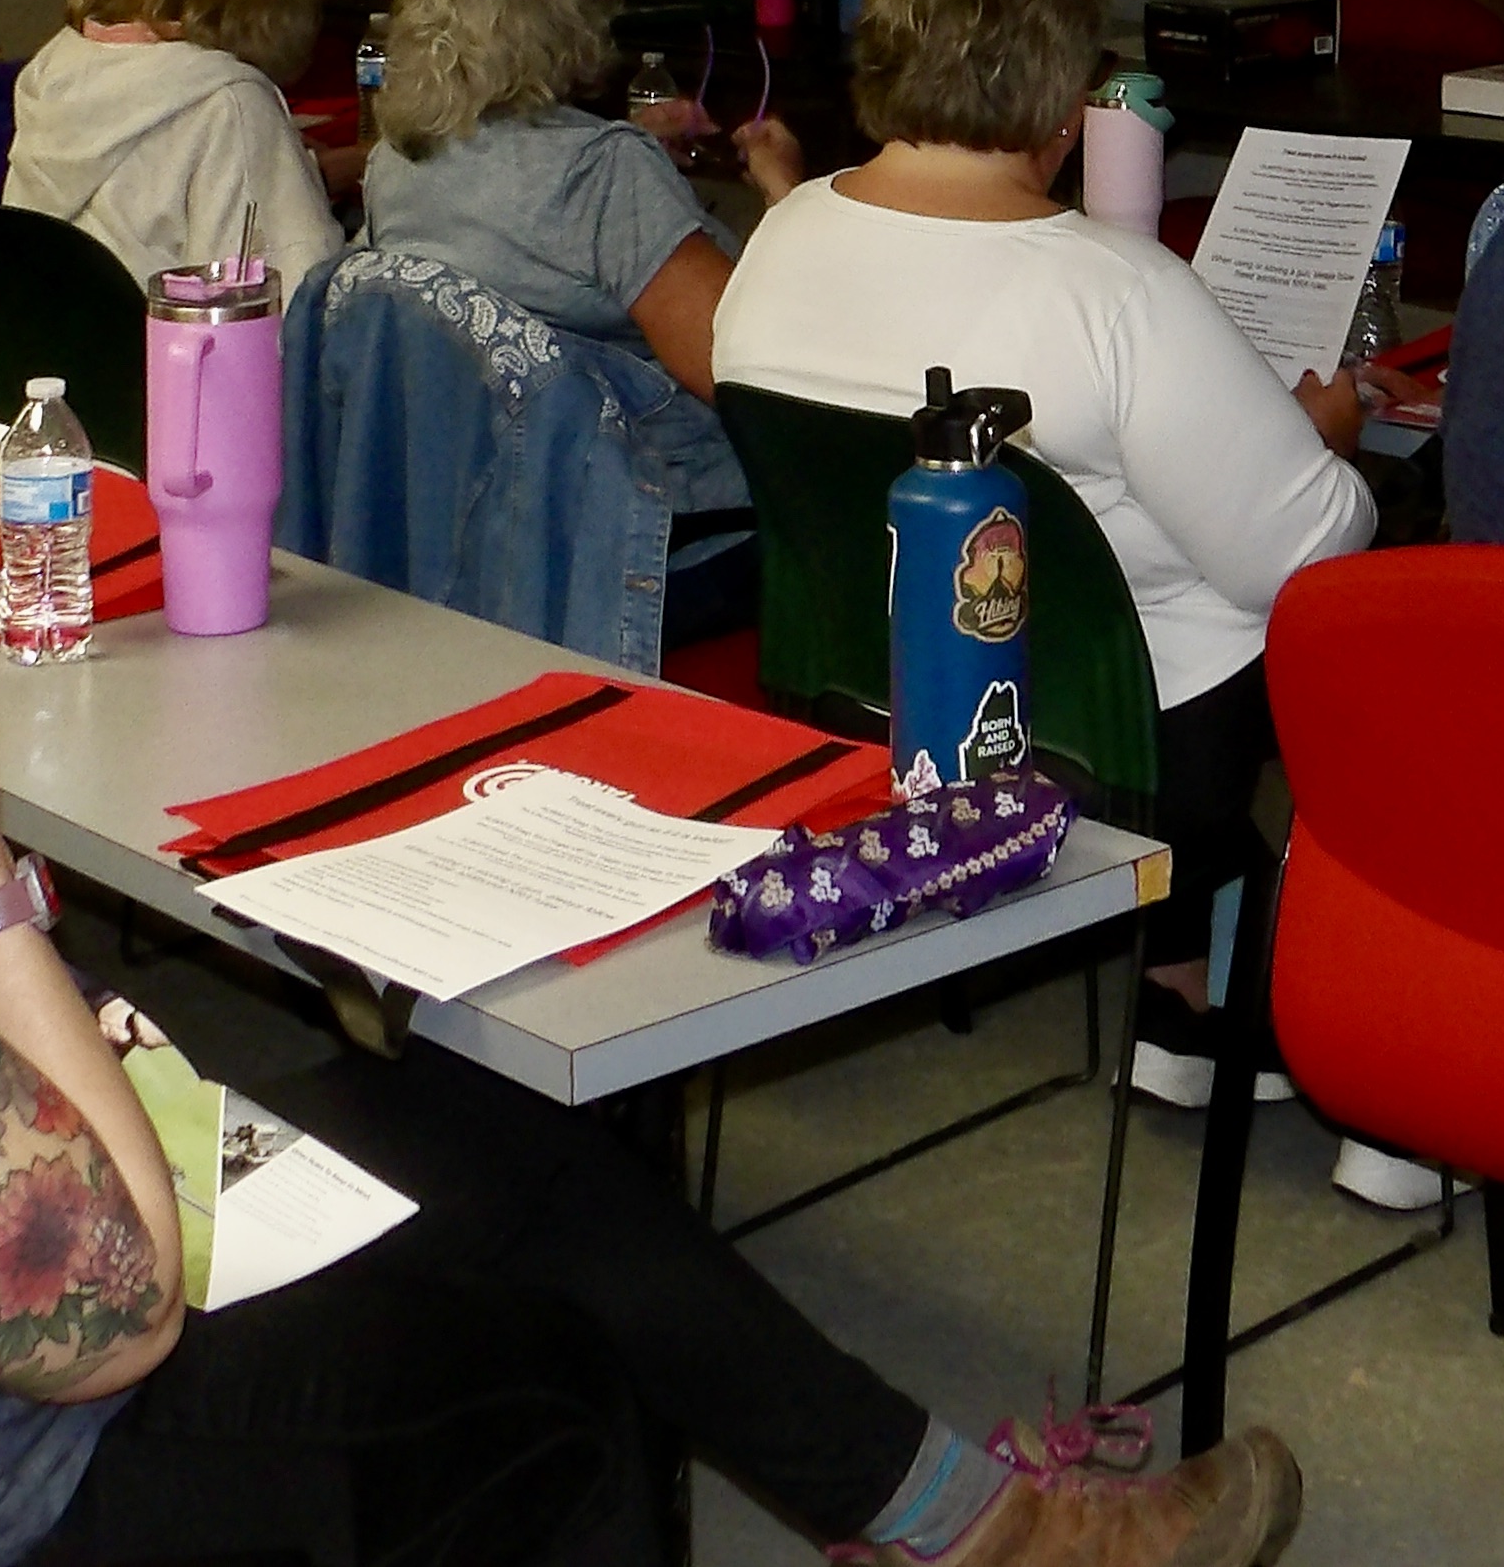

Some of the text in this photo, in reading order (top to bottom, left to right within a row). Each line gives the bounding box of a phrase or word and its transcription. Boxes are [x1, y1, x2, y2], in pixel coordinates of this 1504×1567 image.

[981, 716, 1012, 733] BORN
[985, 730, 1009, 744] AND
[978, 740, 1016, 758] RAISED
